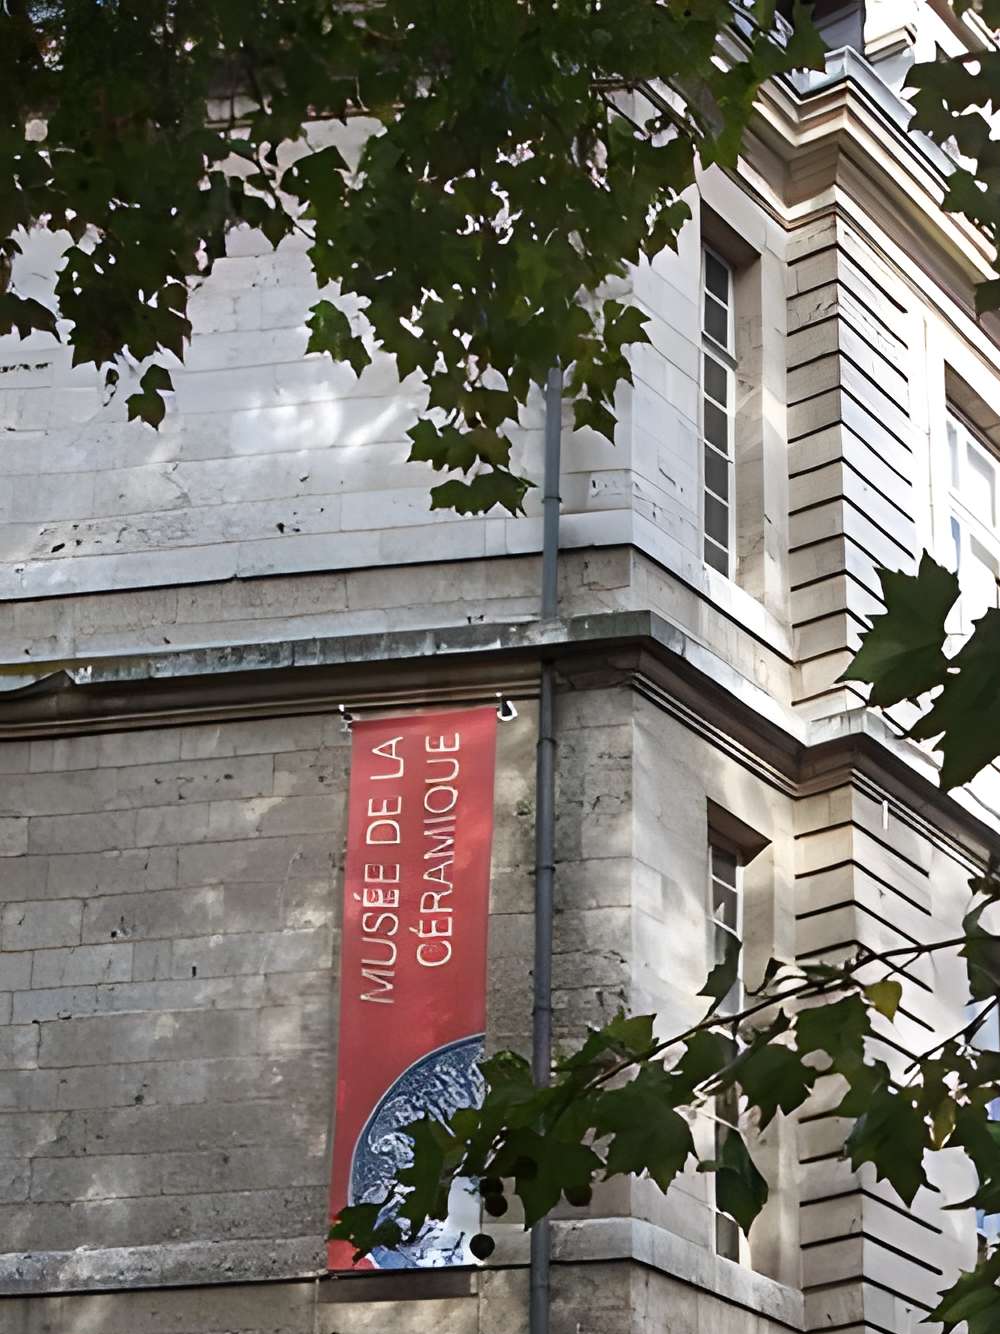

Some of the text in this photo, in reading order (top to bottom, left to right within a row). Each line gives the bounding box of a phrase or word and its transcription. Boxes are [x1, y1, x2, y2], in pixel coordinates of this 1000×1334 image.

[353, 736, 404, 1003] MUSÉE DE LA
[409, 733, 460, 967] CÉRAMIQUE
